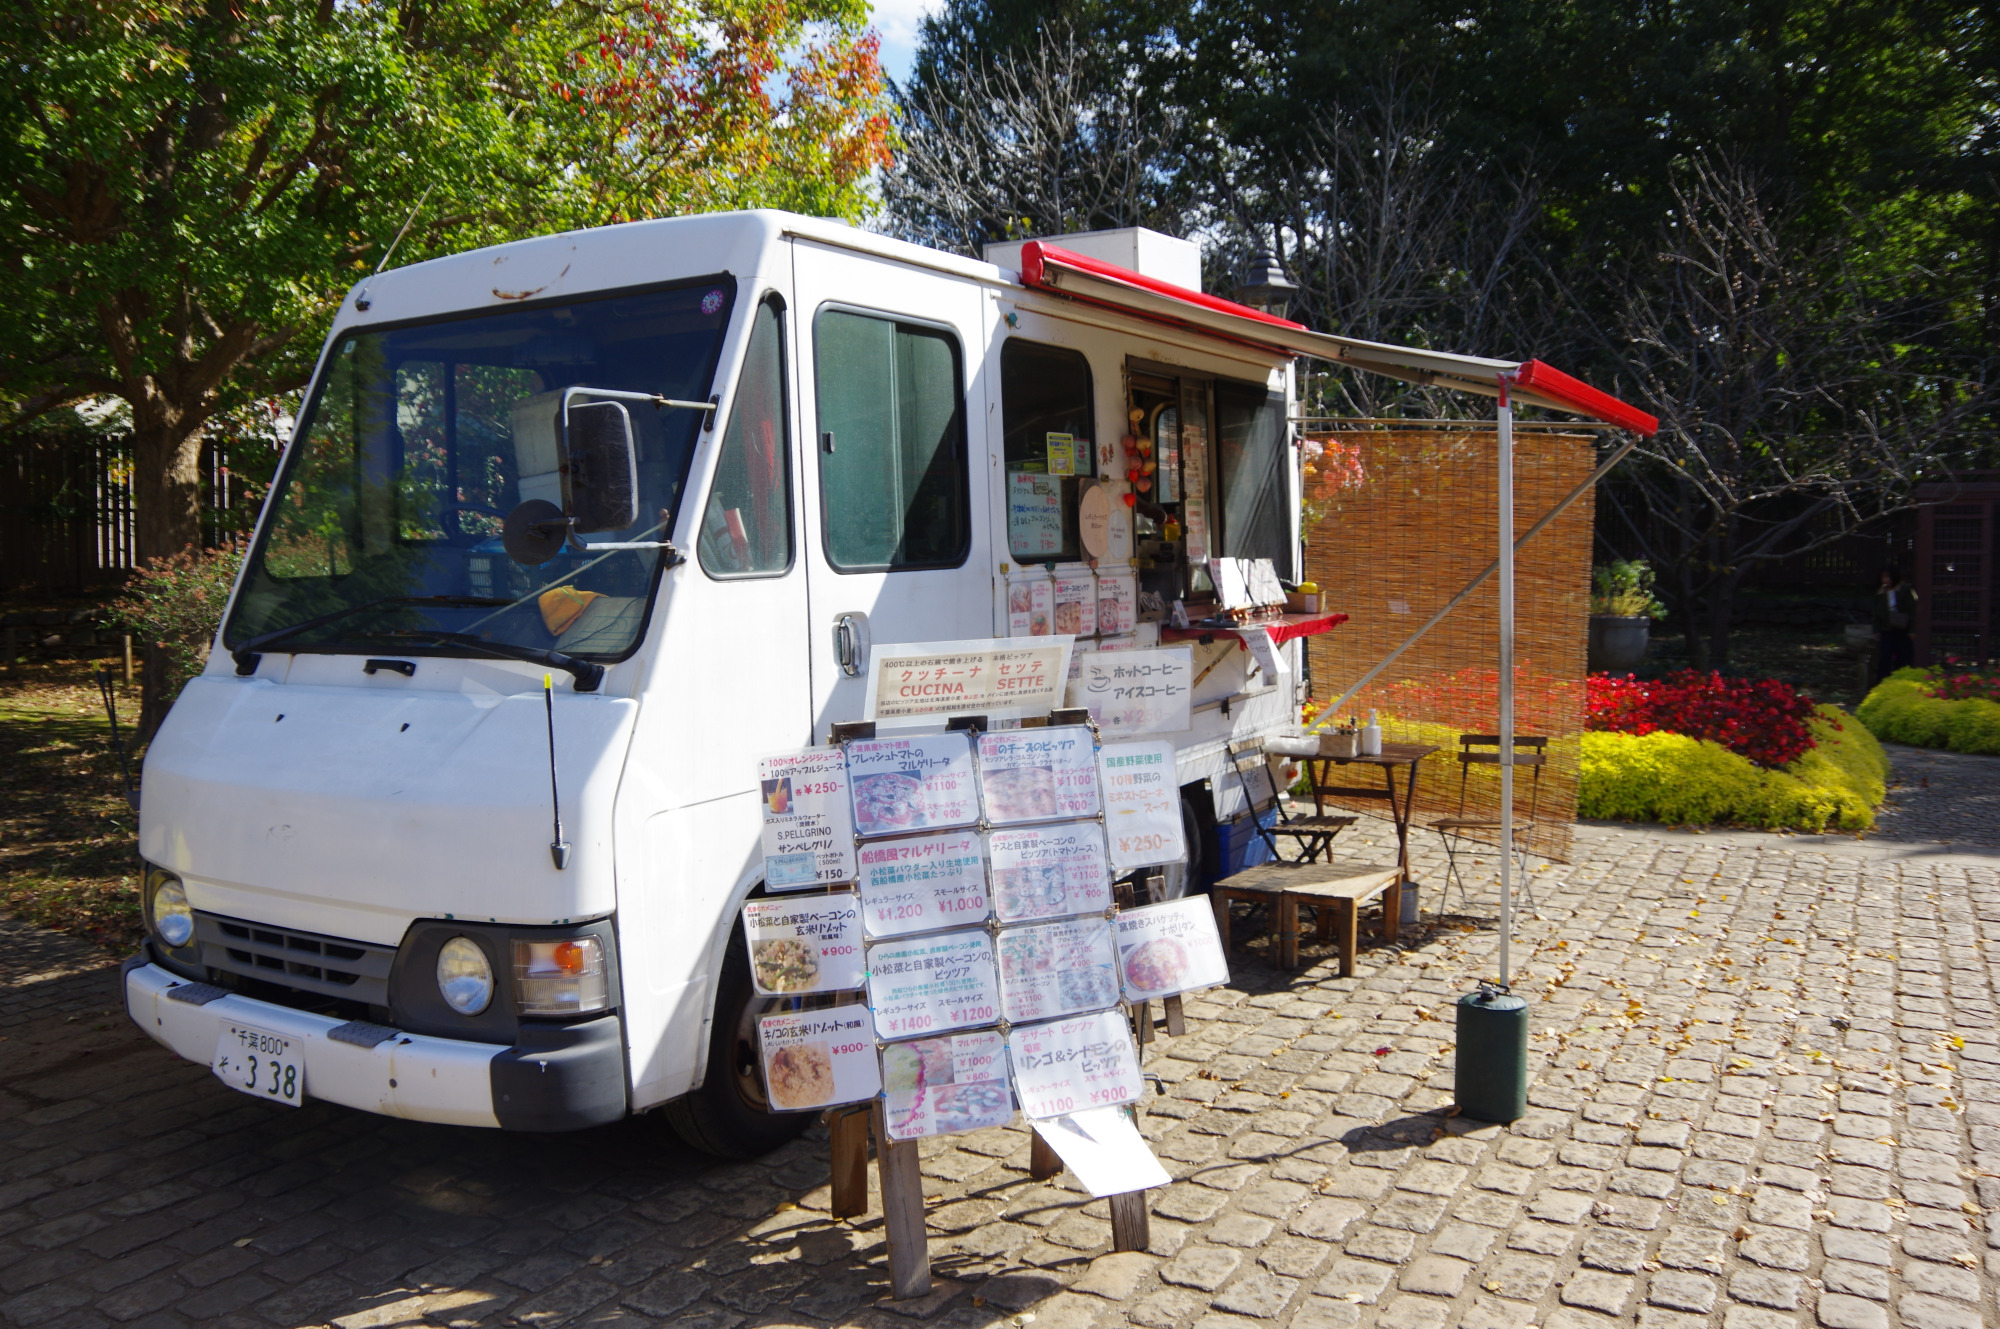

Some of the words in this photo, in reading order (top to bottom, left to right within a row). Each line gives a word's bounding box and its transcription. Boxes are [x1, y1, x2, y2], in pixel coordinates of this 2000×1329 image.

[901, 665, 982, 682] クッチーナ
[999, 661, 1043, 675] セッテ
[1114, 663, 1183, 678] ホットコーヒー
[900, 682, 964, 697] CUCINA
[997, 675, 1044, 690] SETTE
[1114, 684, 1186, 699] アイスコーヒー
[849, 740, 910, 753] 千葉県産トマト使用
[769, 752, 843, 767] 100%オレンジジュース
[852, 748, 924, 764] フレッシュトマトの
[898, 757, 950, 770] マルゲリータ
[1106, 753, 1163, 768] 国産野菜使用
[771, 763, 843, 778] 100%アップルジュース
[922, 771, 967, 781] レギュラーサイズ
[1054, 766, 1096, 776] レギュラーサイズ
[1110, 772, 1161, 786] 10種野菜の
[1057, 791, 1096, 800] スモールサイズ
[1109, 789, 1164, 802] ミネストローネ
[927, 800, 967, 809] スモールサイズ
[778, 827, 831, 840] S.PELLGRINO
[778, 840, 833, 853] サンペレグリノ
[993, 836, 1076, 852] ナスと自家製ベーコンの
[861, 841, 971, 864] 船橋風マルゲリータ
[870, 856, 979, 877] 小松菜パウダー入り生地使用
[871, 867, 963, 886] 西船橋産小松菜たっぷり
[934, 884, 978, 897] スモールサイズ
[865, 893, 915, 906] レギュラーサイズ
[938, 896, 983, 913] ¥1,000
[750, 909, 856, 928] 小松菜と自家製ベーコンの
[877, 903, 923, 921] ¥1,200
[795, 922, 847, 936] 玄米リゾット
[1160, 921, 1195, 936] ナポリタン
[872, 951, 991, 977] 小松菜と自家製ベーコンの
[938, 994, 983, 1007] スモールサイズ
[876, 1002, 926, 1016] レギュラーサイズ
[762, 1018, 801, 1028] 気まぐれメニュー
[1020, 1027, 1055, 1041] デザート
[956, 1036, 995, 1048] マルゲリータ
[1020, 1039, 1126, 1070] リンゴ&シナモンの
[1084, 1068, 1128, 1083] スモールサイズ
[1023, 1079, 1071, 1094] レギュラーサイズ
